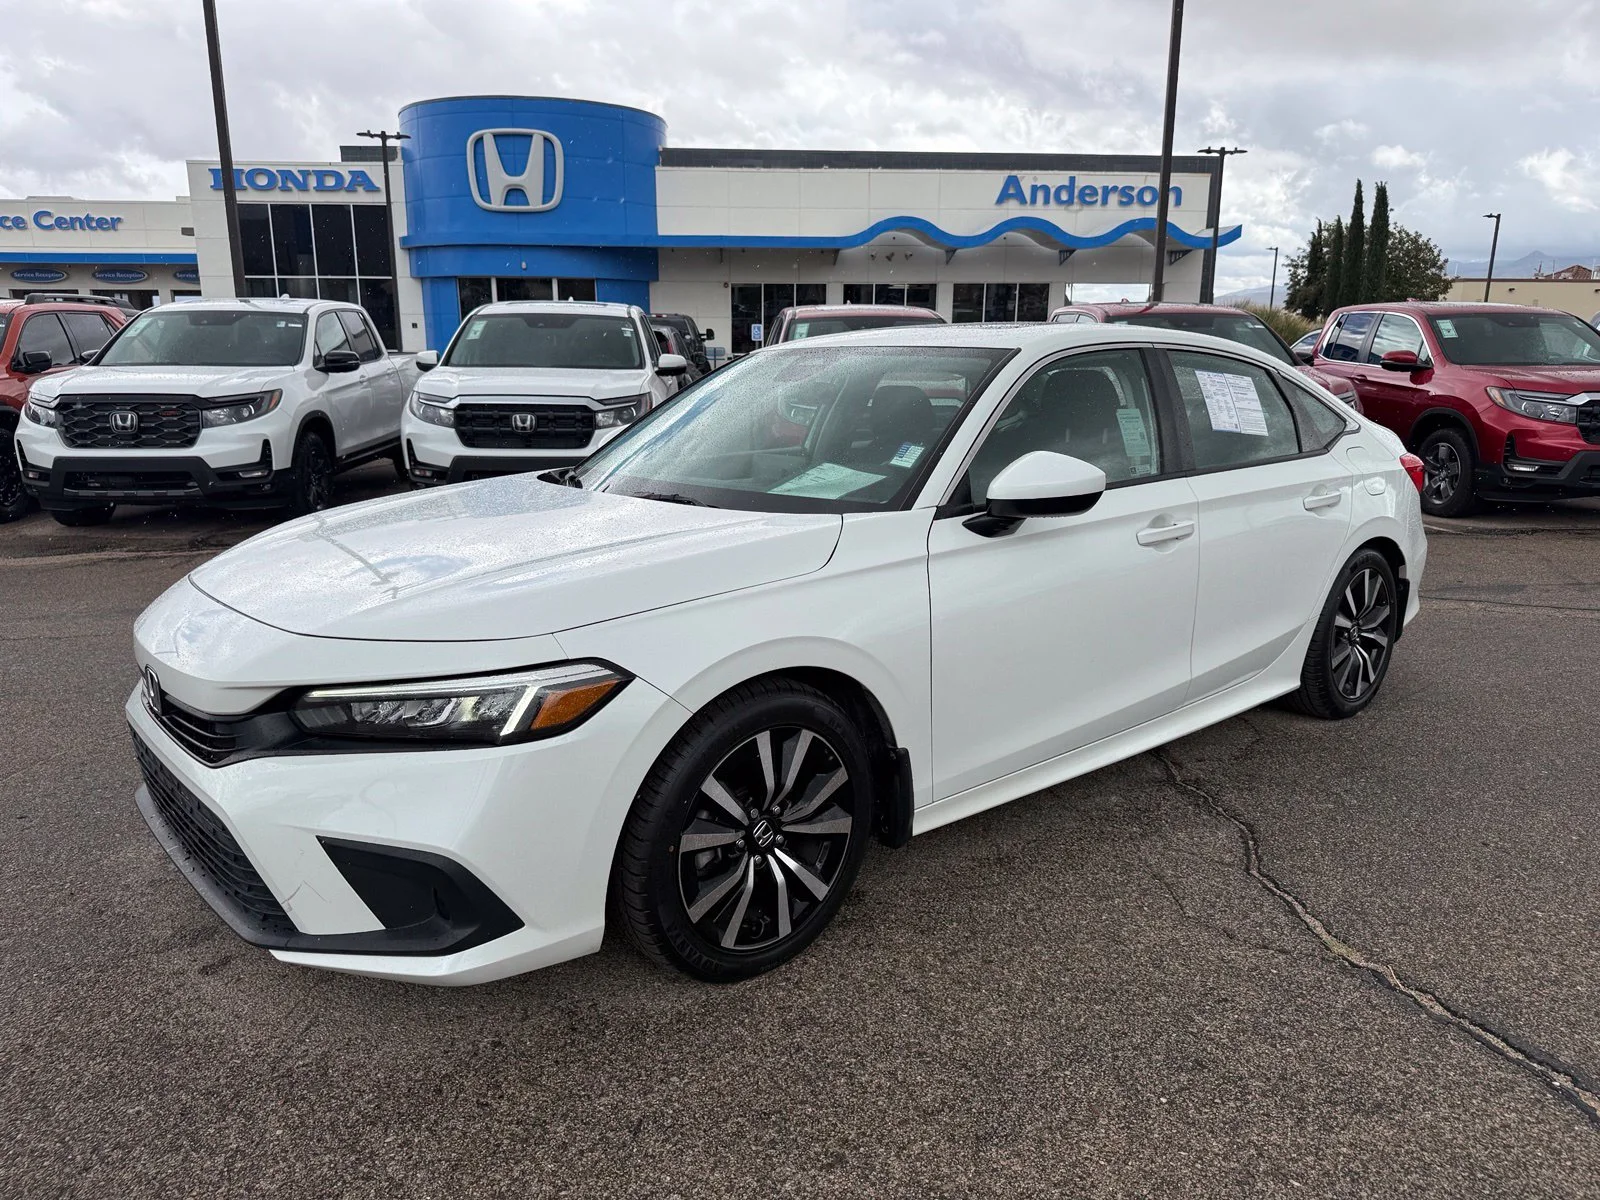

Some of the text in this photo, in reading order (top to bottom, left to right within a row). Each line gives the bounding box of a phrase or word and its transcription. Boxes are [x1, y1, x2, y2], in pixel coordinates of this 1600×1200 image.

[208, 168, 381, 192] HONDA
[995, 175, 1183, 207] Anderson
[33, 210, 123, 231] Center
[35, 271, 63, 279] Reception
